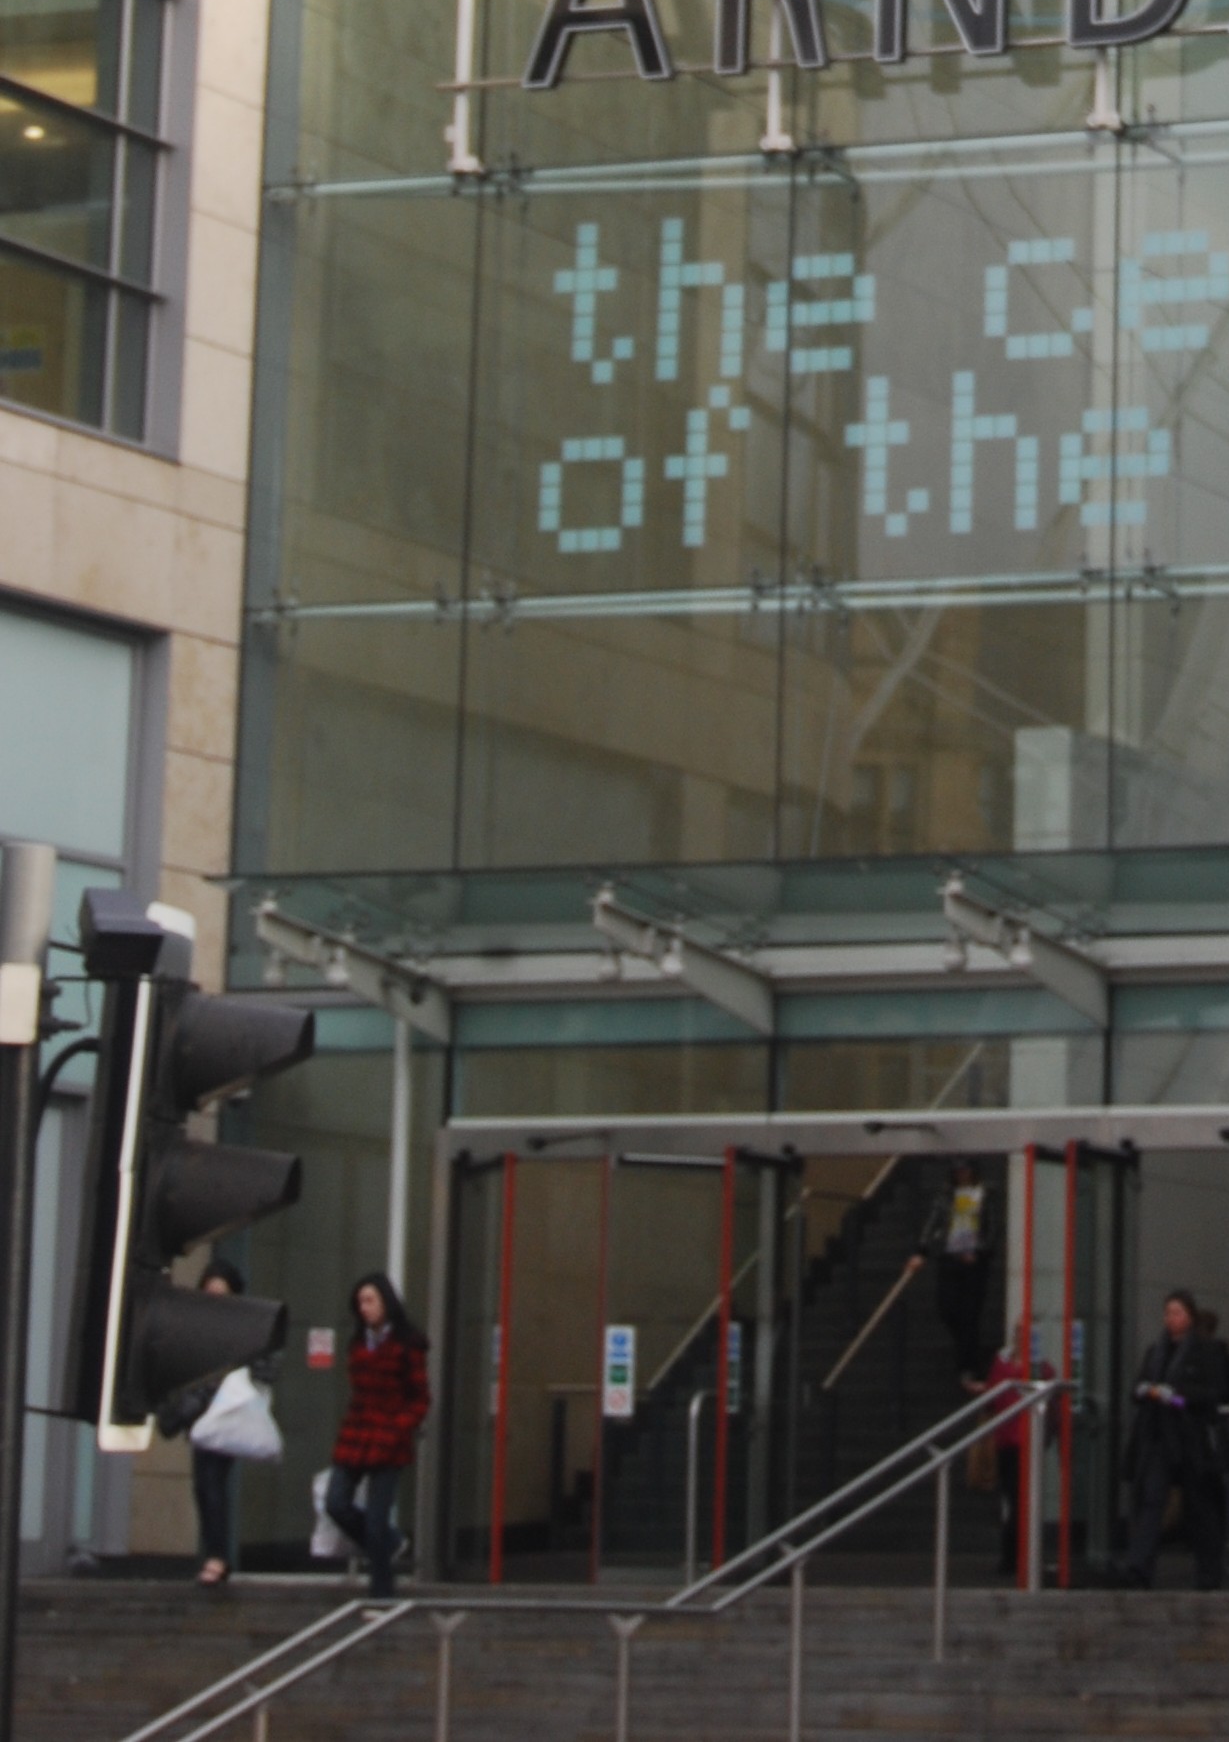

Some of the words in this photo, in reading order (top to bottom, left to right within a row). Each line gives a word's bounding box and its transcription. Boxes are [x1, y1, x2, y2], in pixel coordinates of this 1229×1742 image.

[554, 217, 876, 384] the
[537, 385, 751, 552] of
[846, 369, 1170, 536] the
